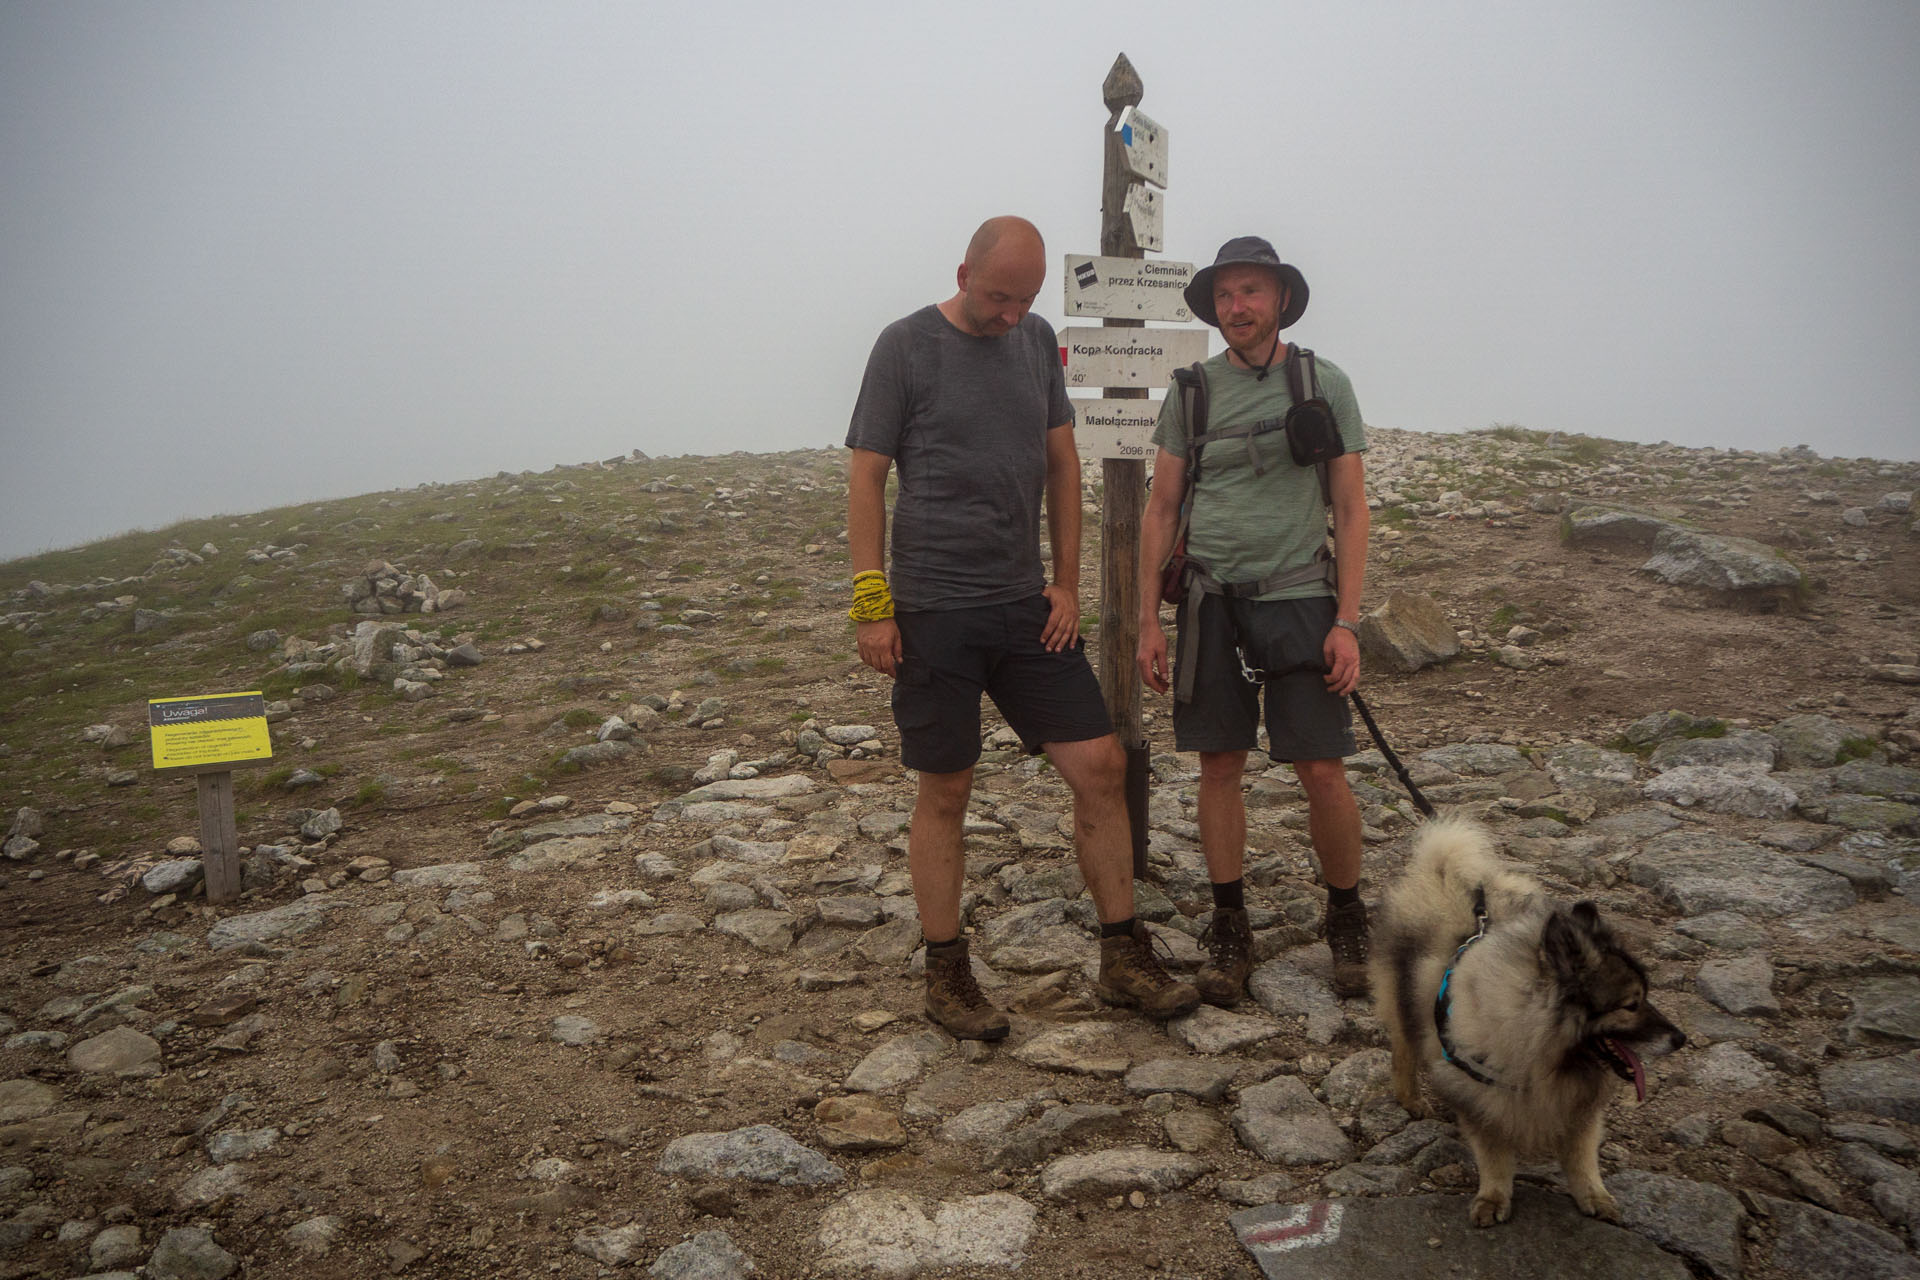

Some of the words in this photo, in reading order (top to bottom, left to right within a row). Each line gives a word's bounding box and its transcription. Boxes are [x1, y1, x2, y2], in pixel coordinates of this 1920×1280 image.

[1145, 264, 1188, 277] Ciemniak
[1109, 276, 1134, 287] przez
[1073, 345, 1101, 357] Kopa
[1105, 345, 1163, 356] Kondracka
[1086, 416, 1157, 428] Małołączniak
[1120, 447, 1143, 456] 2096
[1146, 448, 1155, 456] m
[163, 707, 208, 718] Uwaga!
